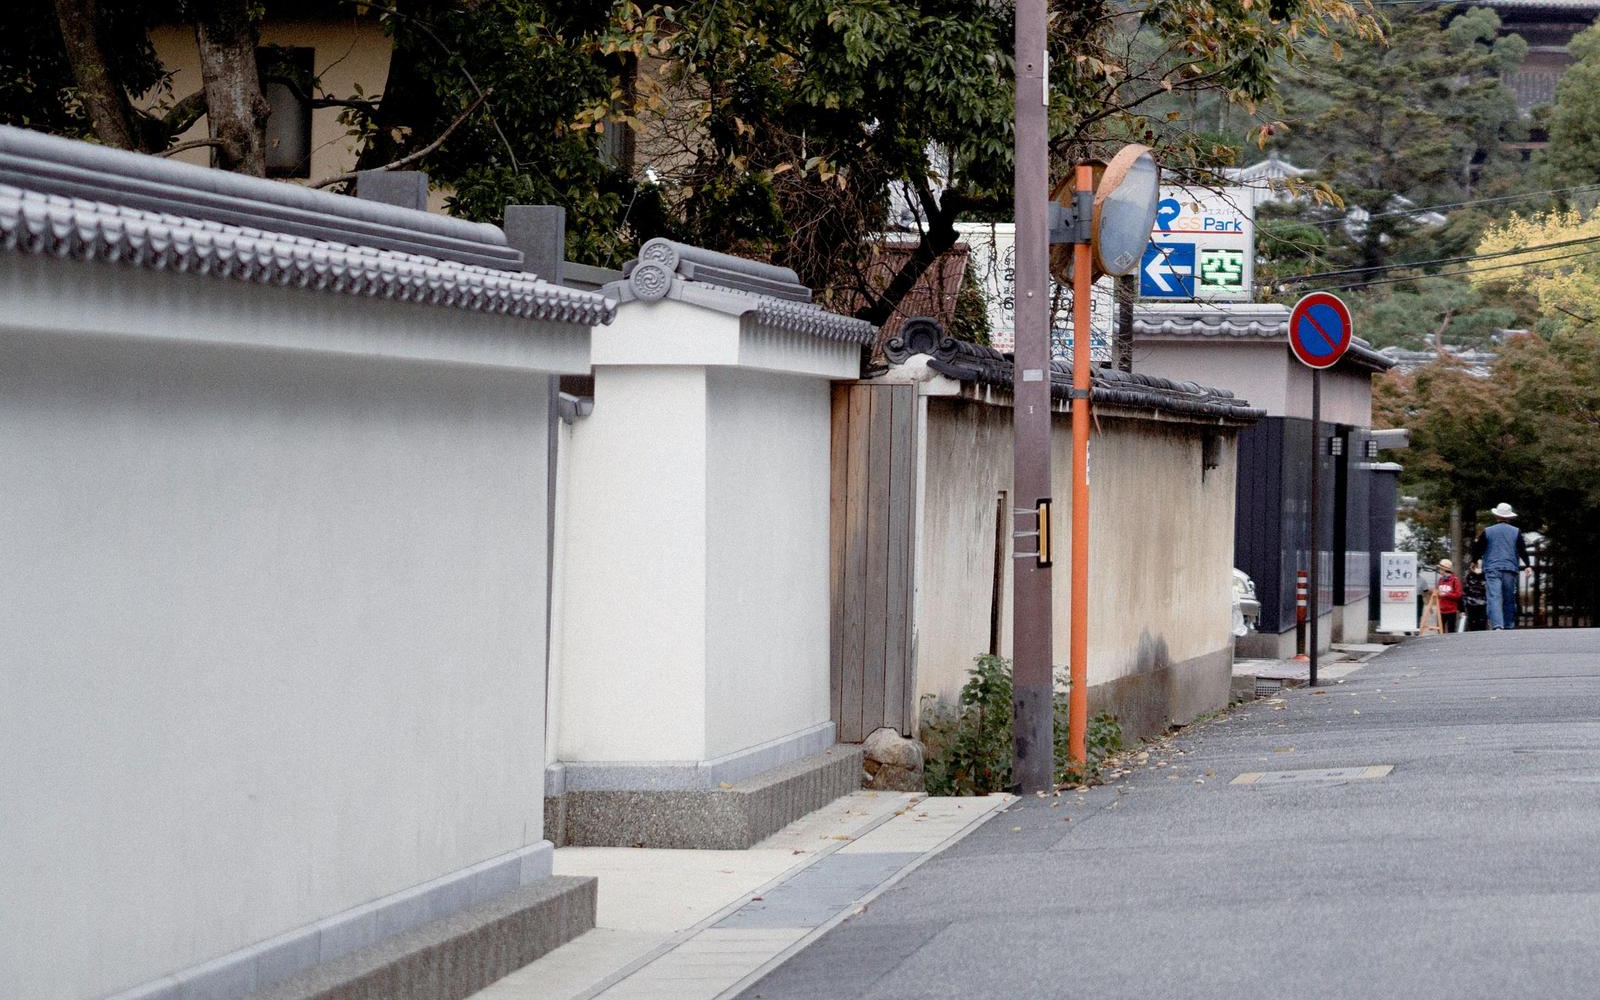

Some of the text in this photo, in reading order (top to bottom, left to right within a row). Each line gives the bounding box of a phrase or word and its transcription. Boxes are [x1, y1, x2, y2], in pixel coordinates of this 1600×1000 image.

[1177, 217, 1242, 231] GS Park
[1201, 250, 1243, 291] 空
